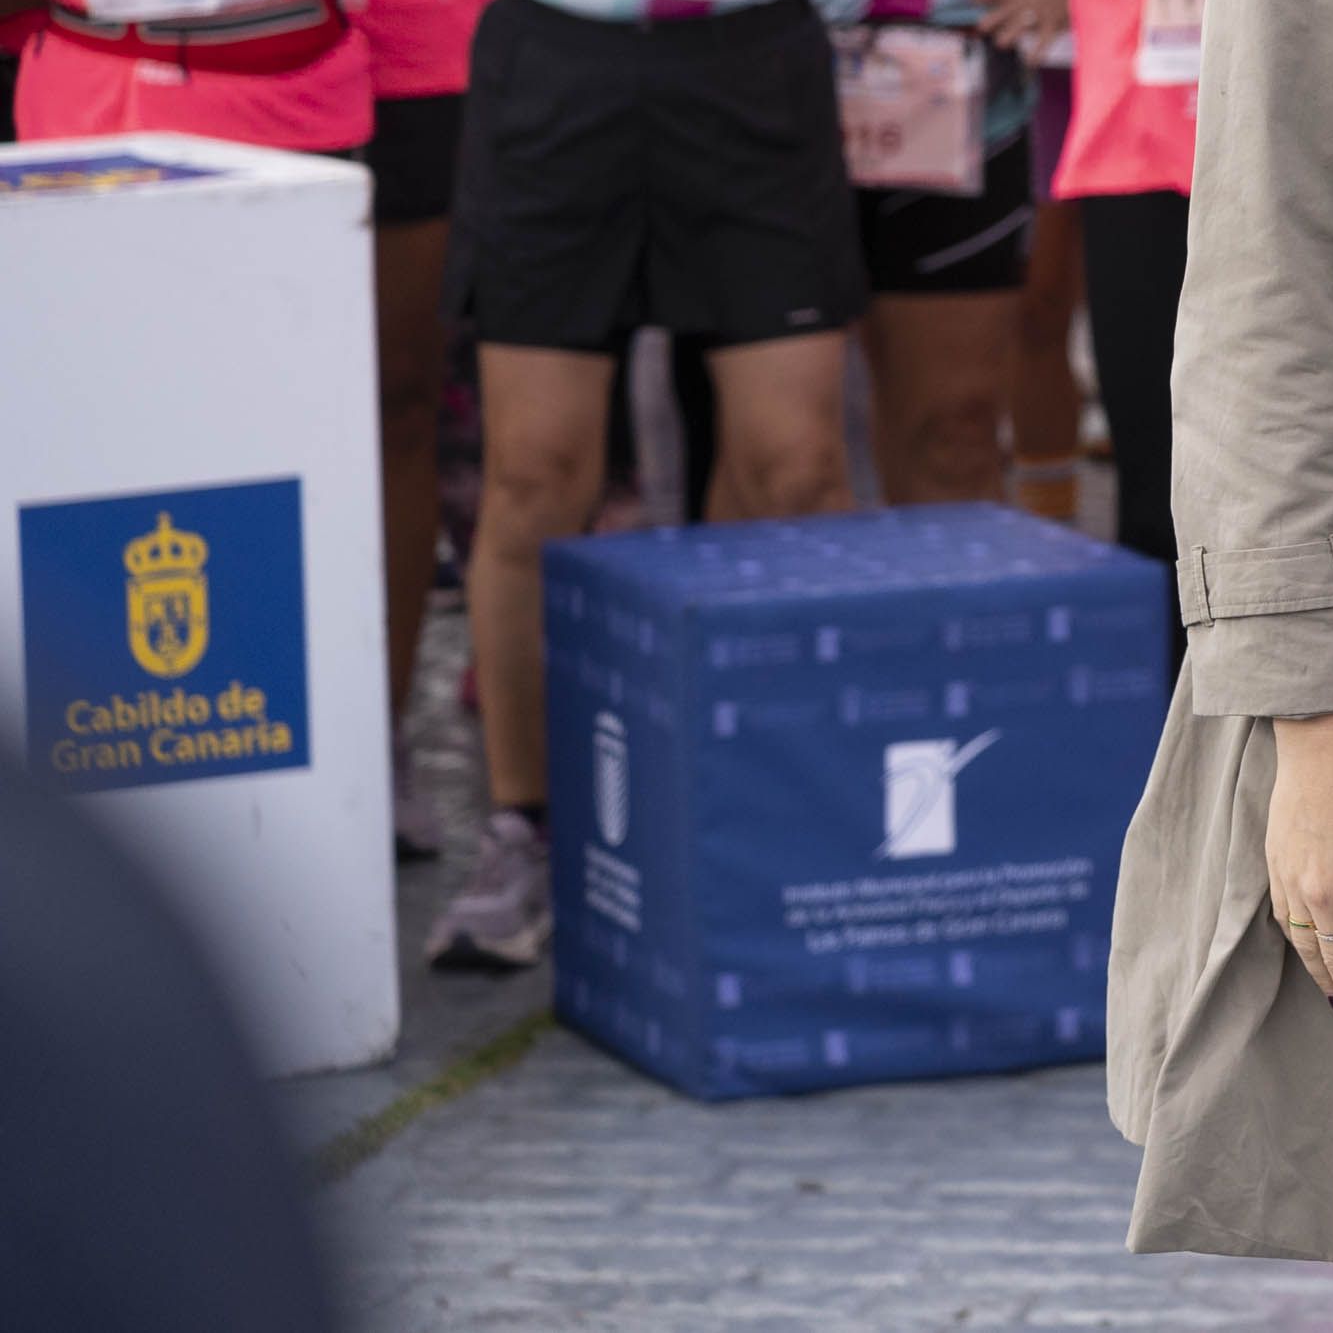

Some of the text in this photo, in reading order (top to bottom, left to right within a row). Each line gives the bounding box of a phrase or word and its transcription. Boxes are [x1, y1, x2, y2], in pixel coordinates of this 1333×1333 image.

[66, 679, 266, 735] Cabildo de
[53, 716, 293, 773] Gran Canaria
